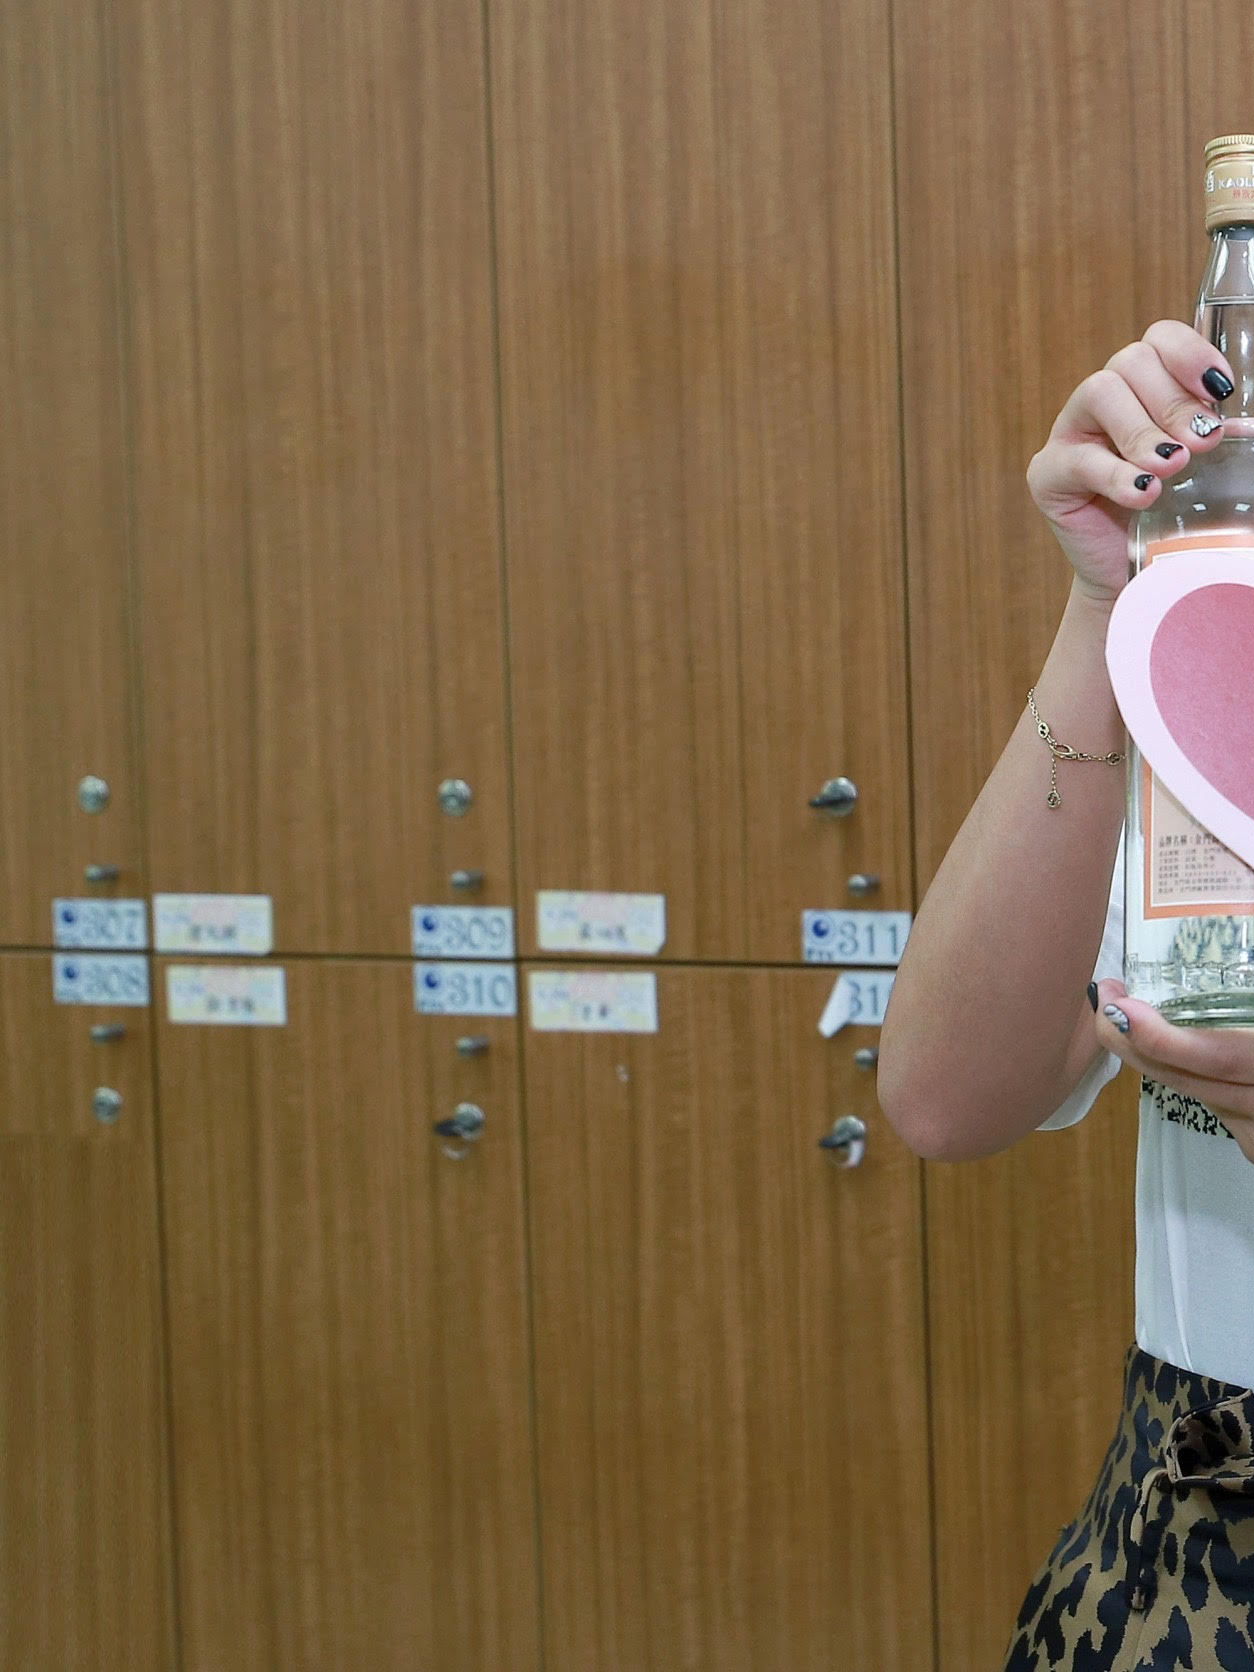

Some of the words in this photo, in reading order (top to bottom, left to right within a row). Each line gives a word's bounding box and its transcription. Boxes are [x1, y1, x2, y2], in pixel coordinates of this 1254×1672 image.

[446, 915, 506, 950] 309
[838, 920, 898, 956] 311
[449, 972, 511, 1008] 310
